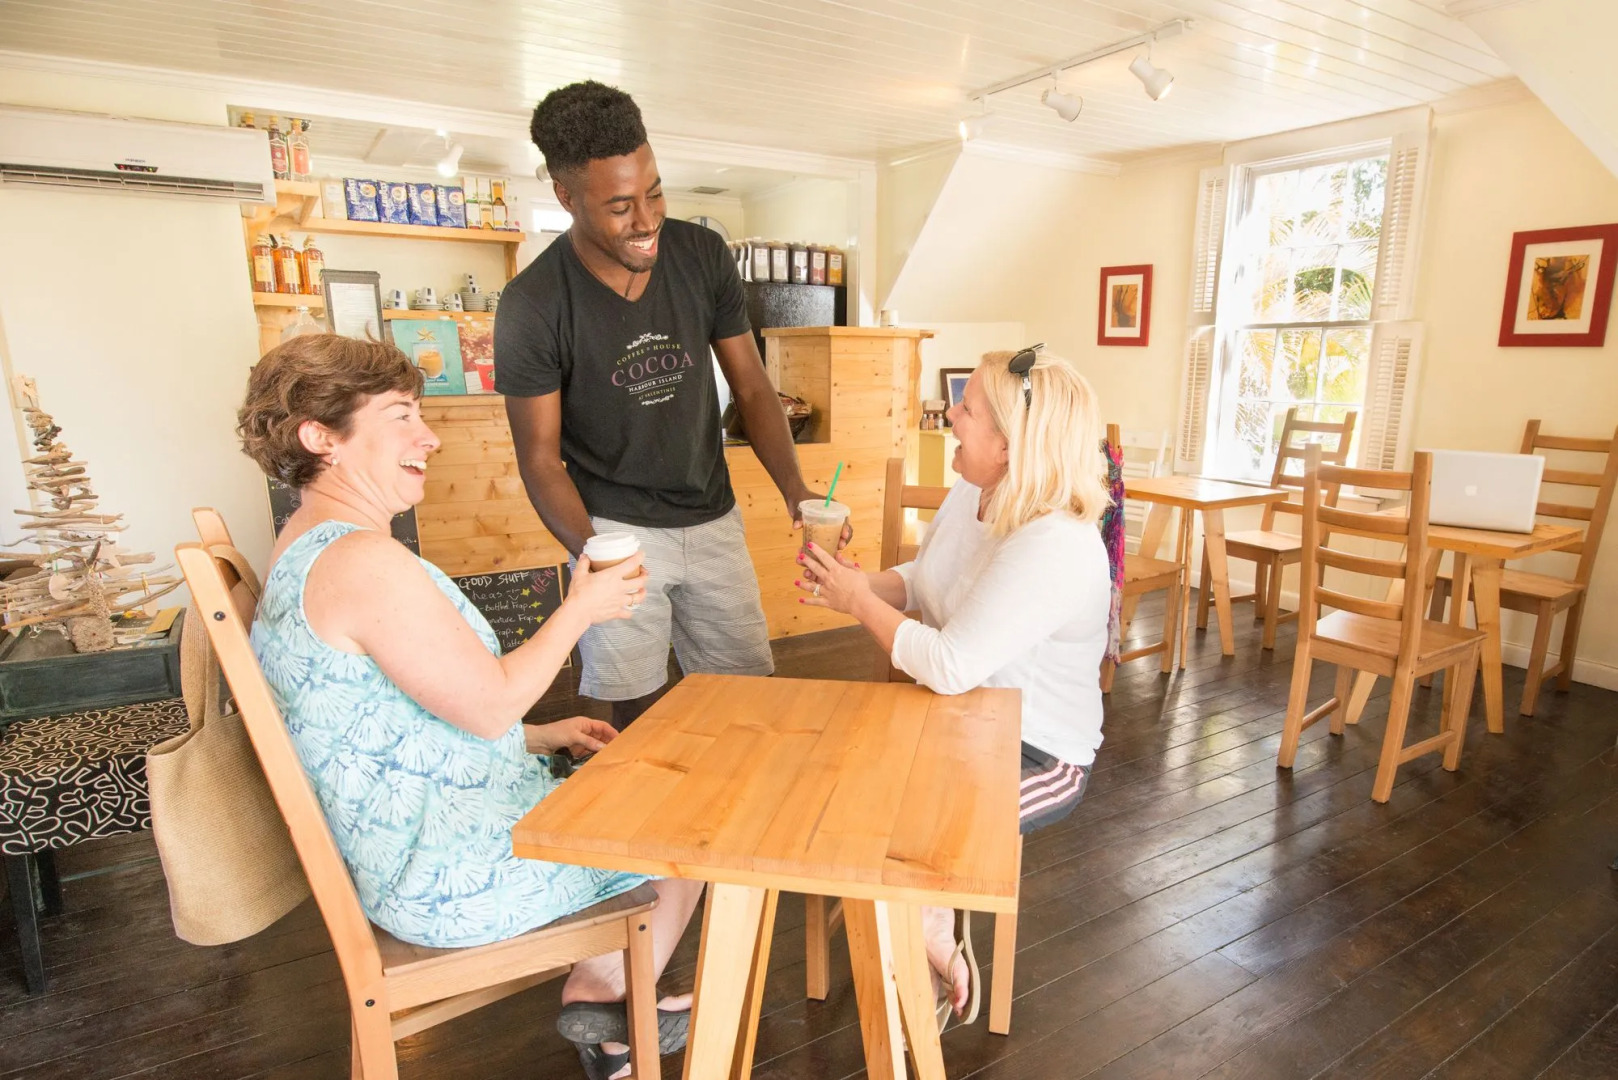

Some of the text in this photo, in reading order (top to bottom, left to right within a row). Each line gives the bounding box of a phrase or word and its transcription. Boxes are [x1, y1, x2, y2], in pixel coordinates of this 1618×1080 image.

[616, 348, 645, 366] COFFEE
[611, 351, 695, 387] COCOA
[628, 374, 683, 393] HARBOUR ISLAND
[459, 576, 493, 590] GOOD
